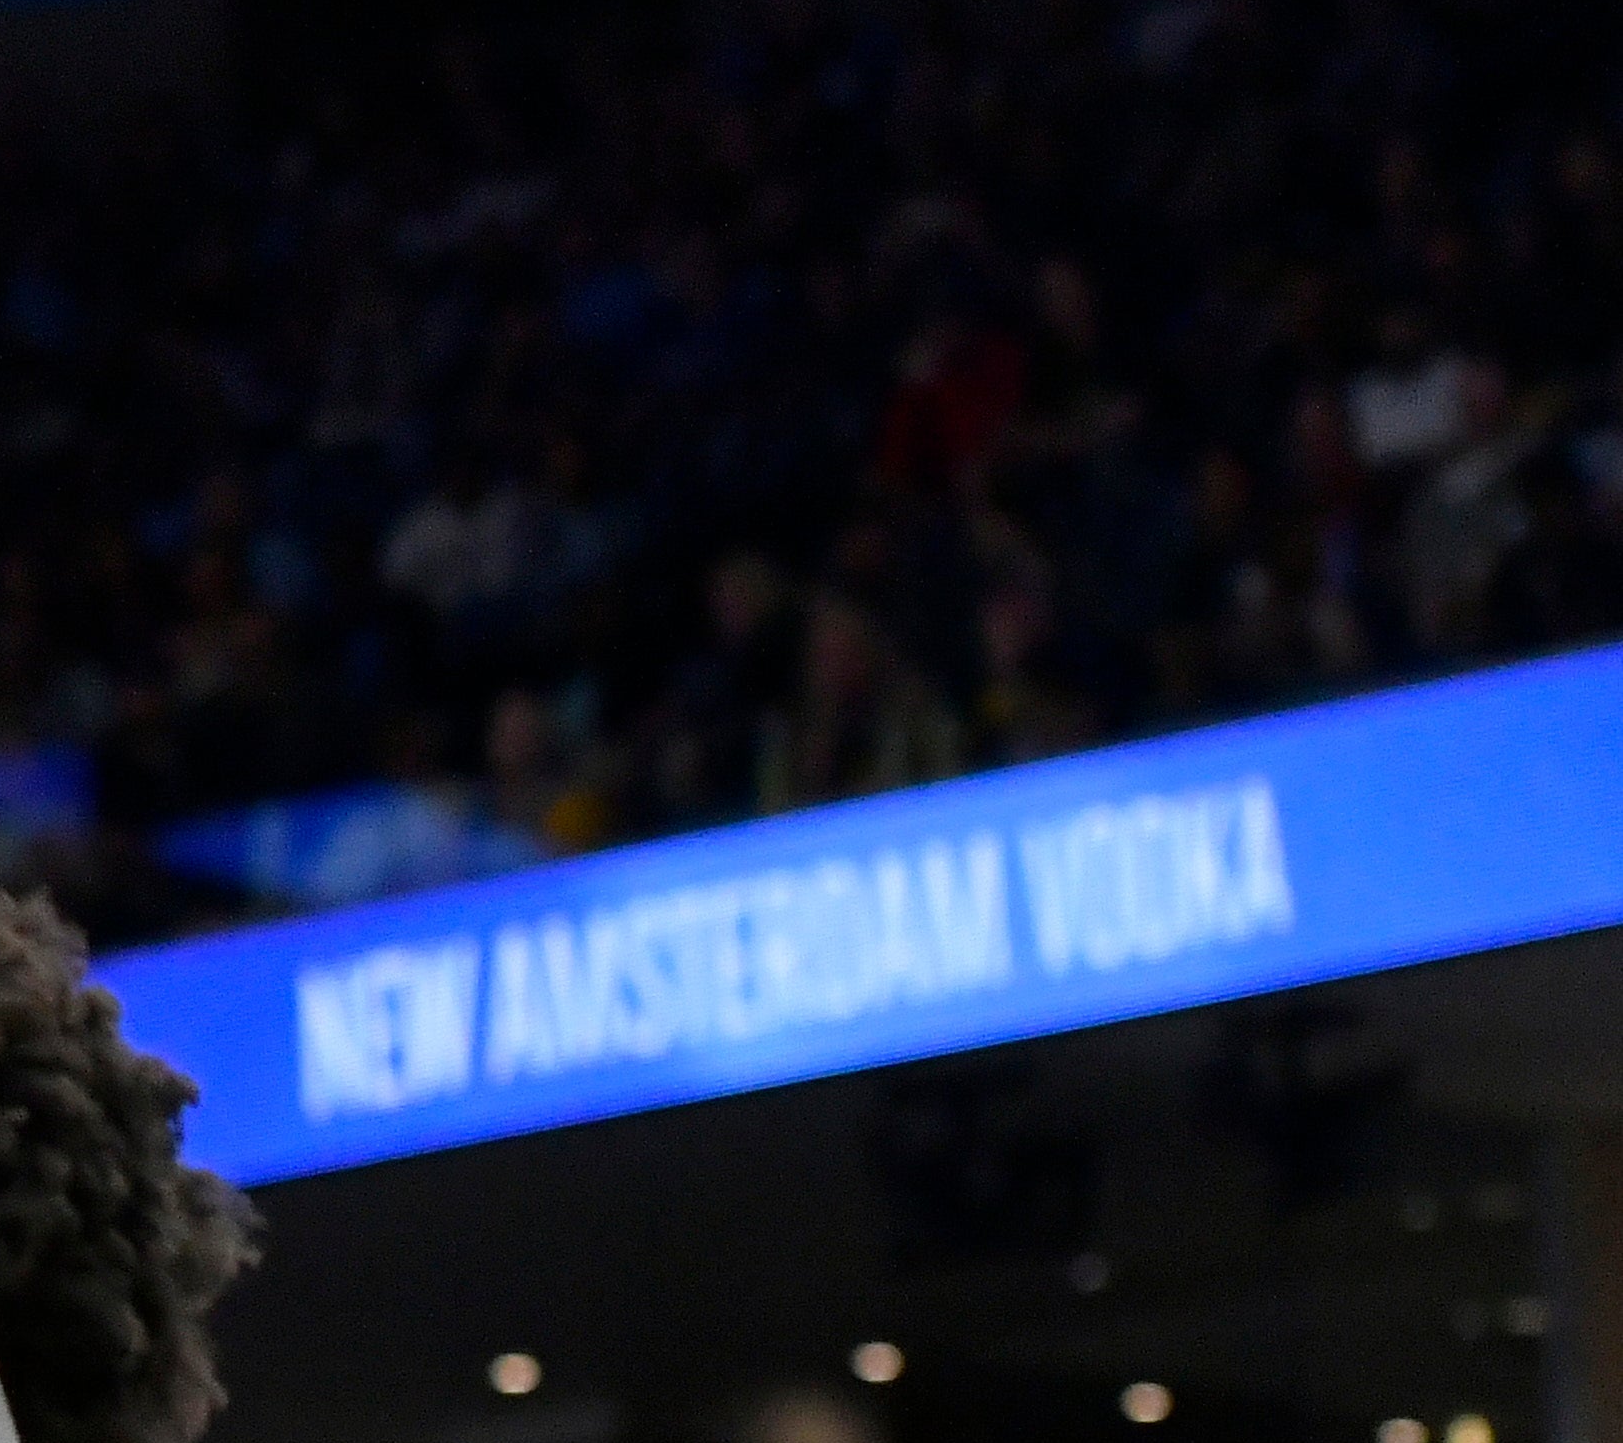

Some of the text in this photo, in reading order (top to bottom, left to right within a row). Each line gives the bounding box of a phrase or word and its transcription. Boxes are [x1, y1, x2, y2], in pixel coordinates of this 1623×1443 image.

[295, 774, 1296, 1122] NEW AMSTERDAM VODKA
